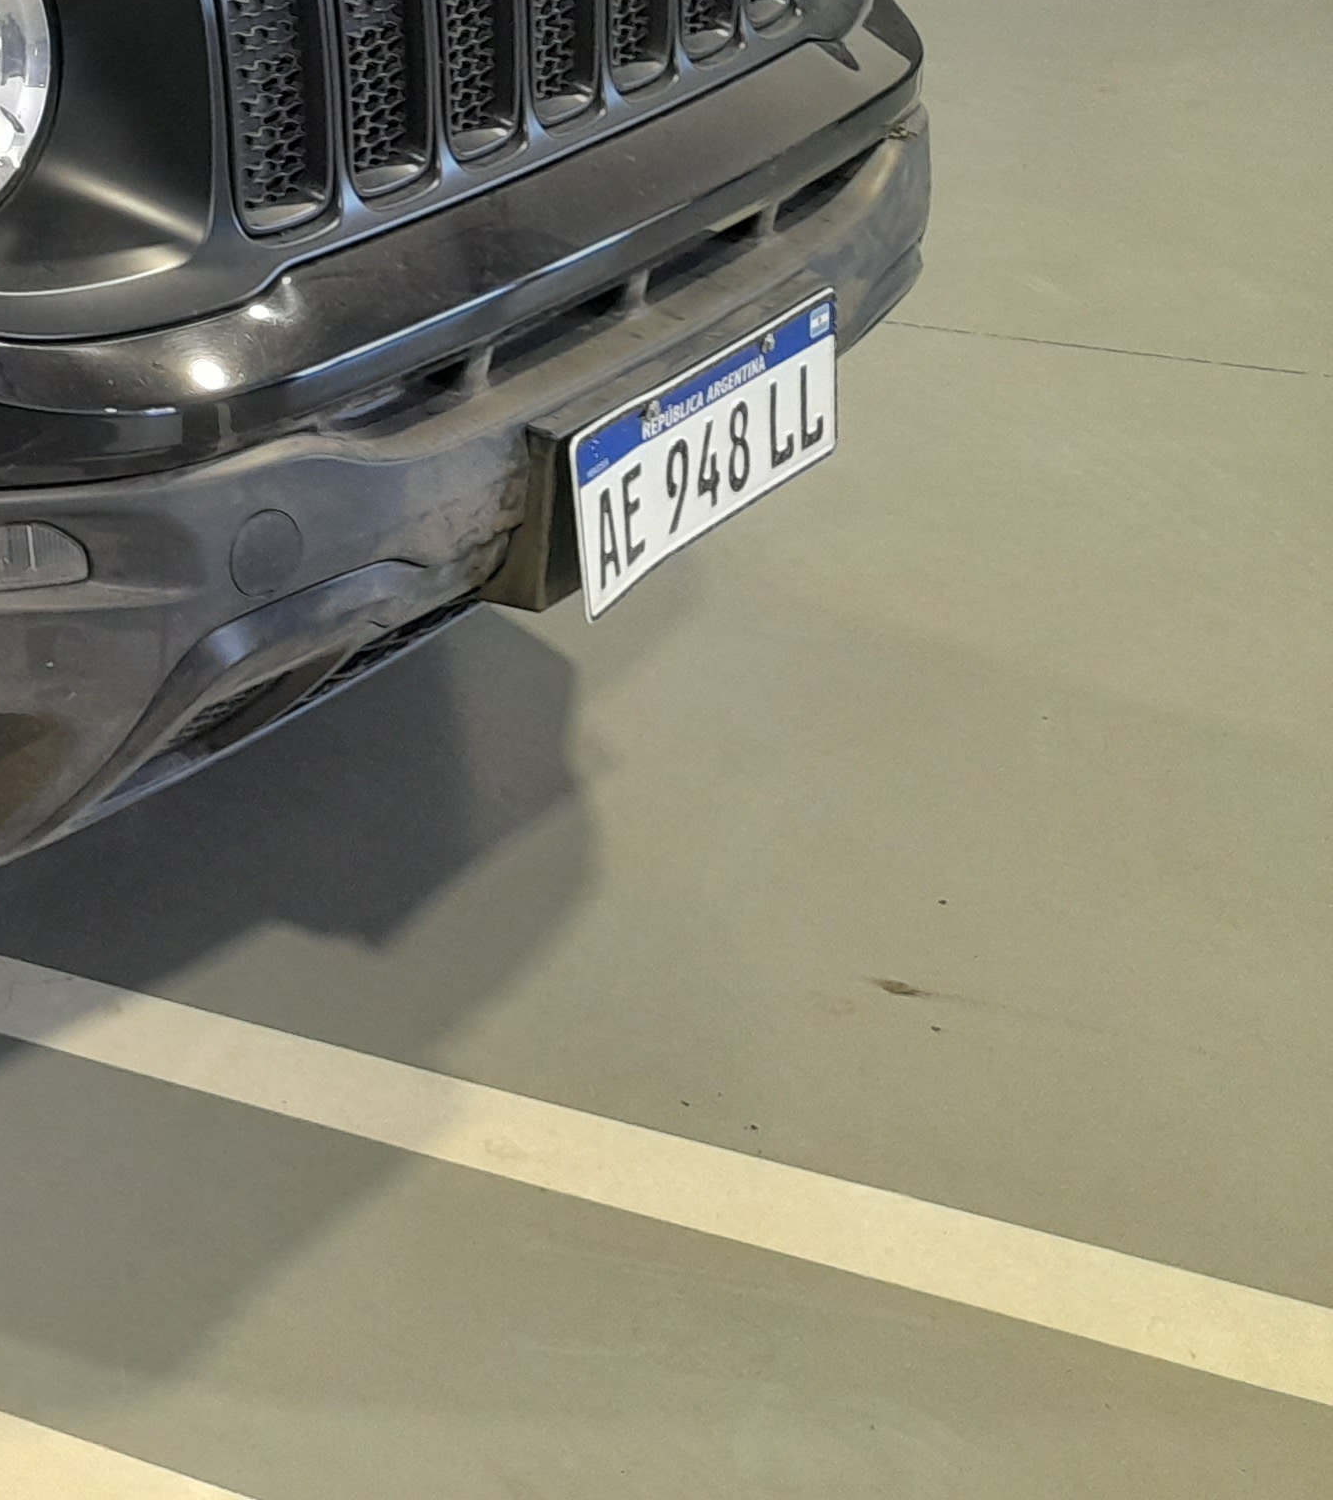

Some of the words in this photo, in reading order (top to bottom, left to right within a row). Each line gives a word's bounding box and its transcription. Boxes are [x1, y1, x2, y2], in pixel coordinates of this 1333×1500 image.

[706, 353, 767, 405] ARGENTINA
[599, 462, 647, 590] AE
[665, 400, 752, 535] 948
[769, 361, 824, 469] LL
